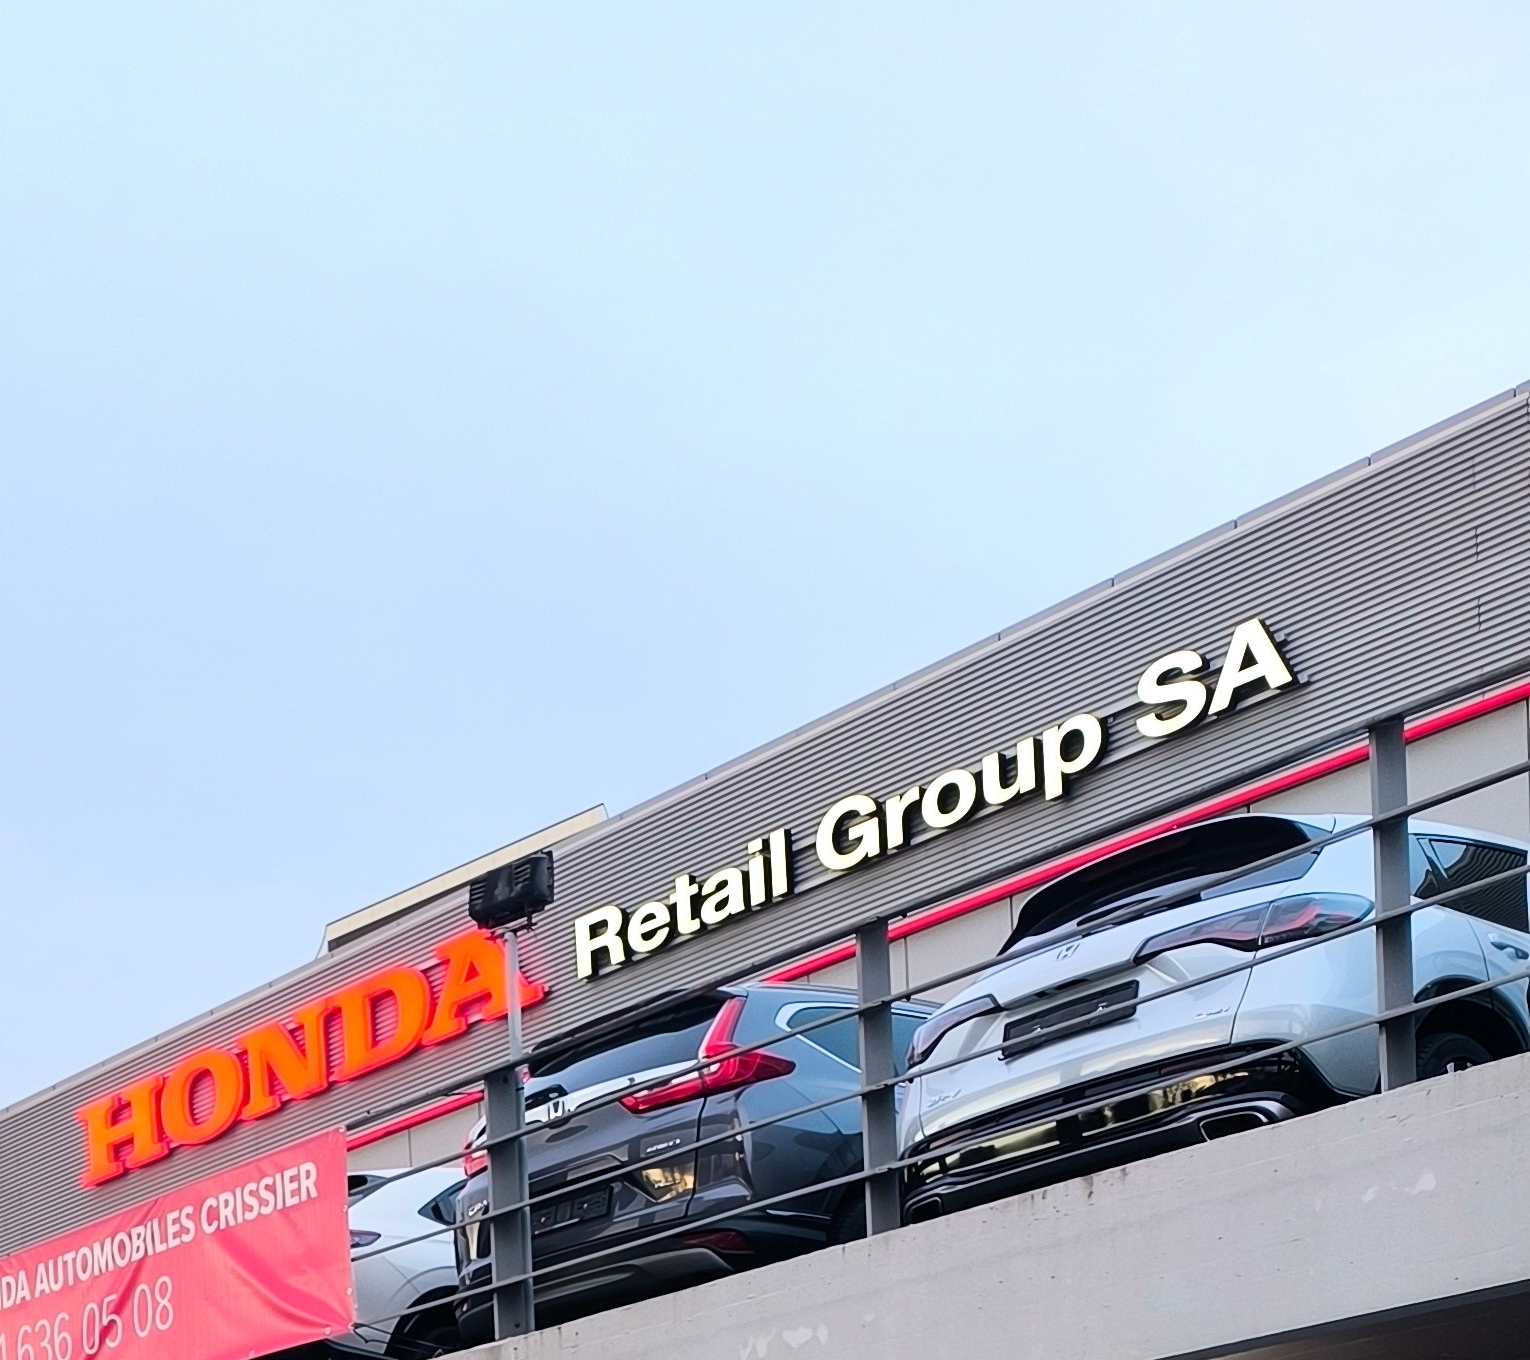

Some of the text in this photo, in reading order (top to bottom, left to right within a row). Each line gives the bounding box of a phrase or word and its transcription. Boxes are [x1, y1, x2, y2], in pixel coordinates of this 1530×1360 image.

[75, 616, 1295, 1190] HONDA Retail Group SA
[34, 1205, 196, 1299] AUTOMOBILES
[200, 1161, 319, 1235] CRISSIER
[81, 1293, 122, 1356] 05
[132, 1275, 174, 1338] 08
